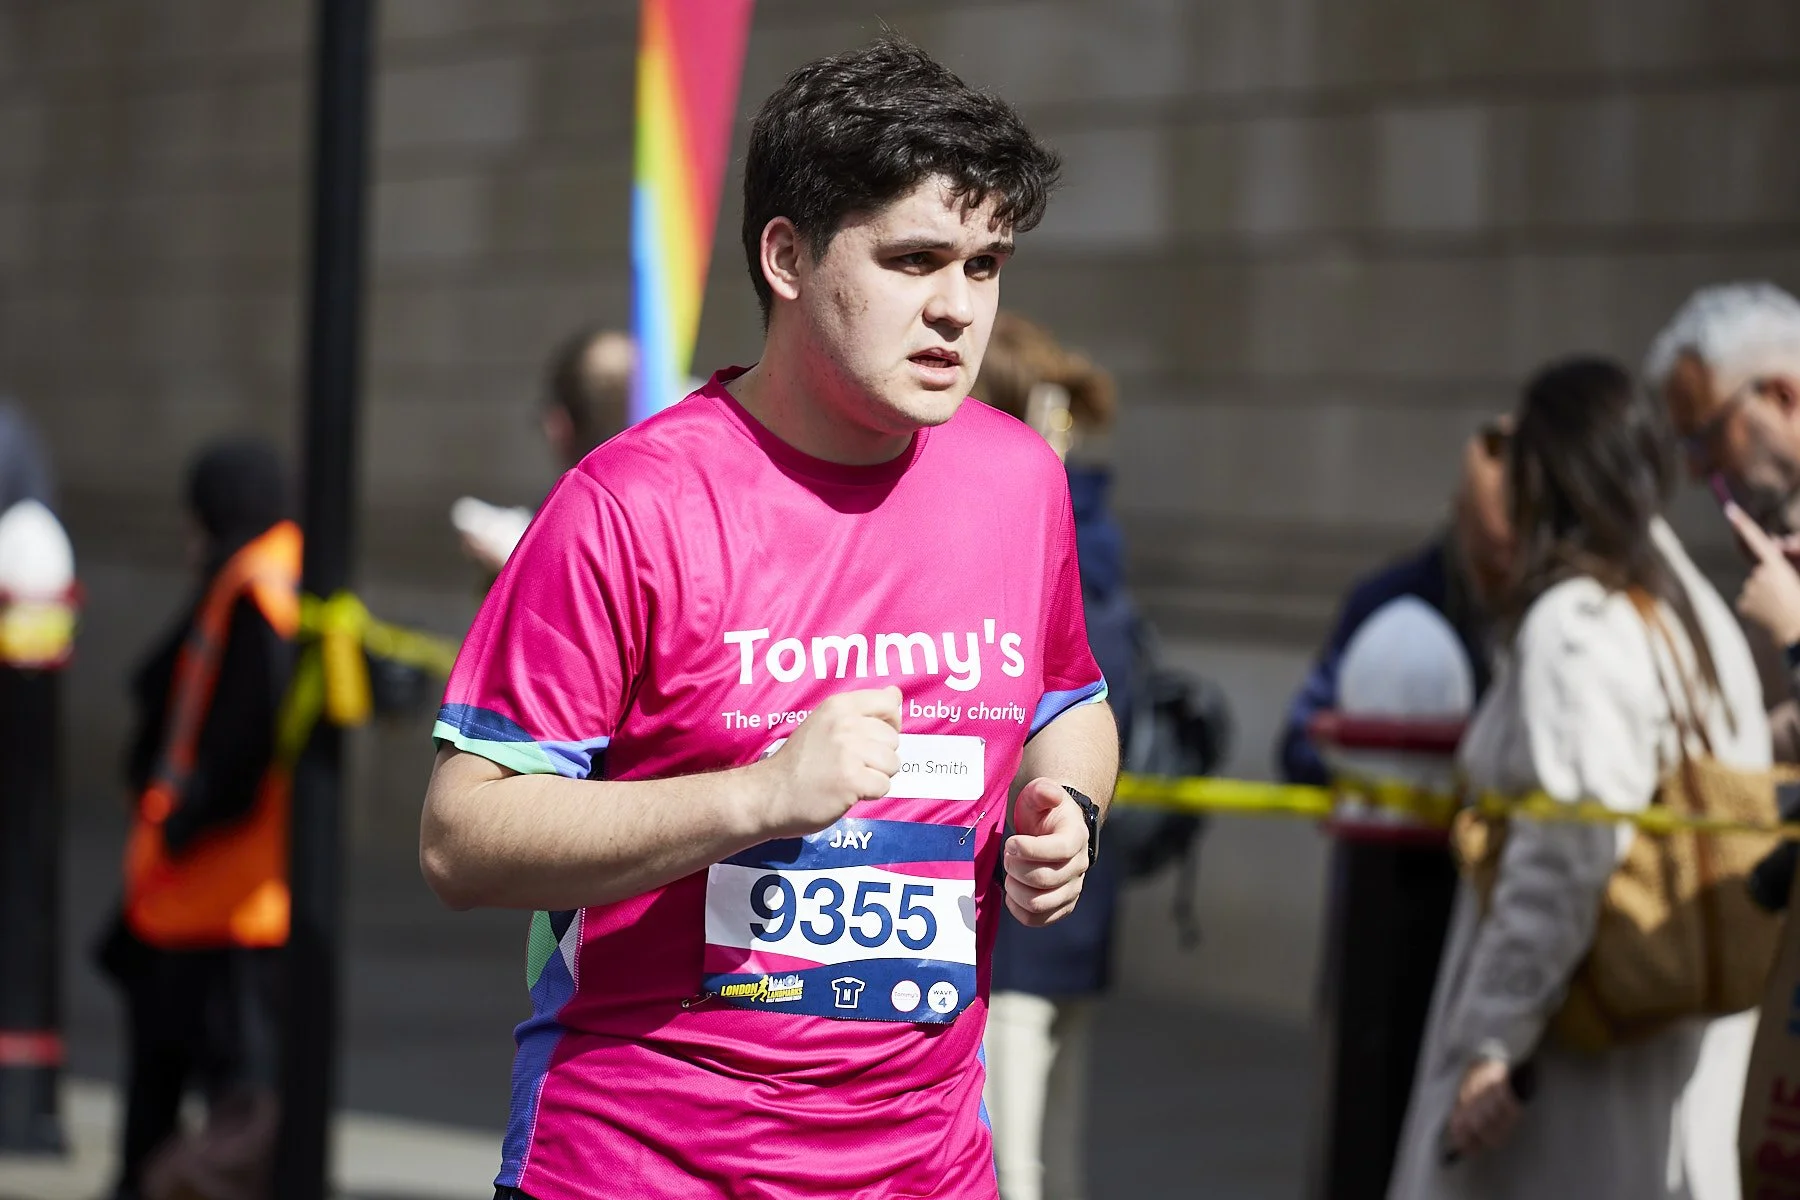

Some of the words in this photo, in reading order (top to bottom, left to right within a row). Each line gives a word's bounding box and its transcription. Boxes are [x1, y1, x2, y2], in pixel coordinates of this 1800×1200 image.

[723, 618, 1025, 691] Tommy's
[722, 709, 760, 729] The
[767, 709, 812, 730] preg
[909, 698, 962, 723] baby
[967, 701, 1026, 725] charity
[901, 762, 920, 773] on
[925, 760, 968, 775] Smith
[829, 830, 873, 849] JAY
[749, 874, 937, 950] 9355
[721, 983, 758, 996] LONDON
[938, 997, 947, 1008] 4
